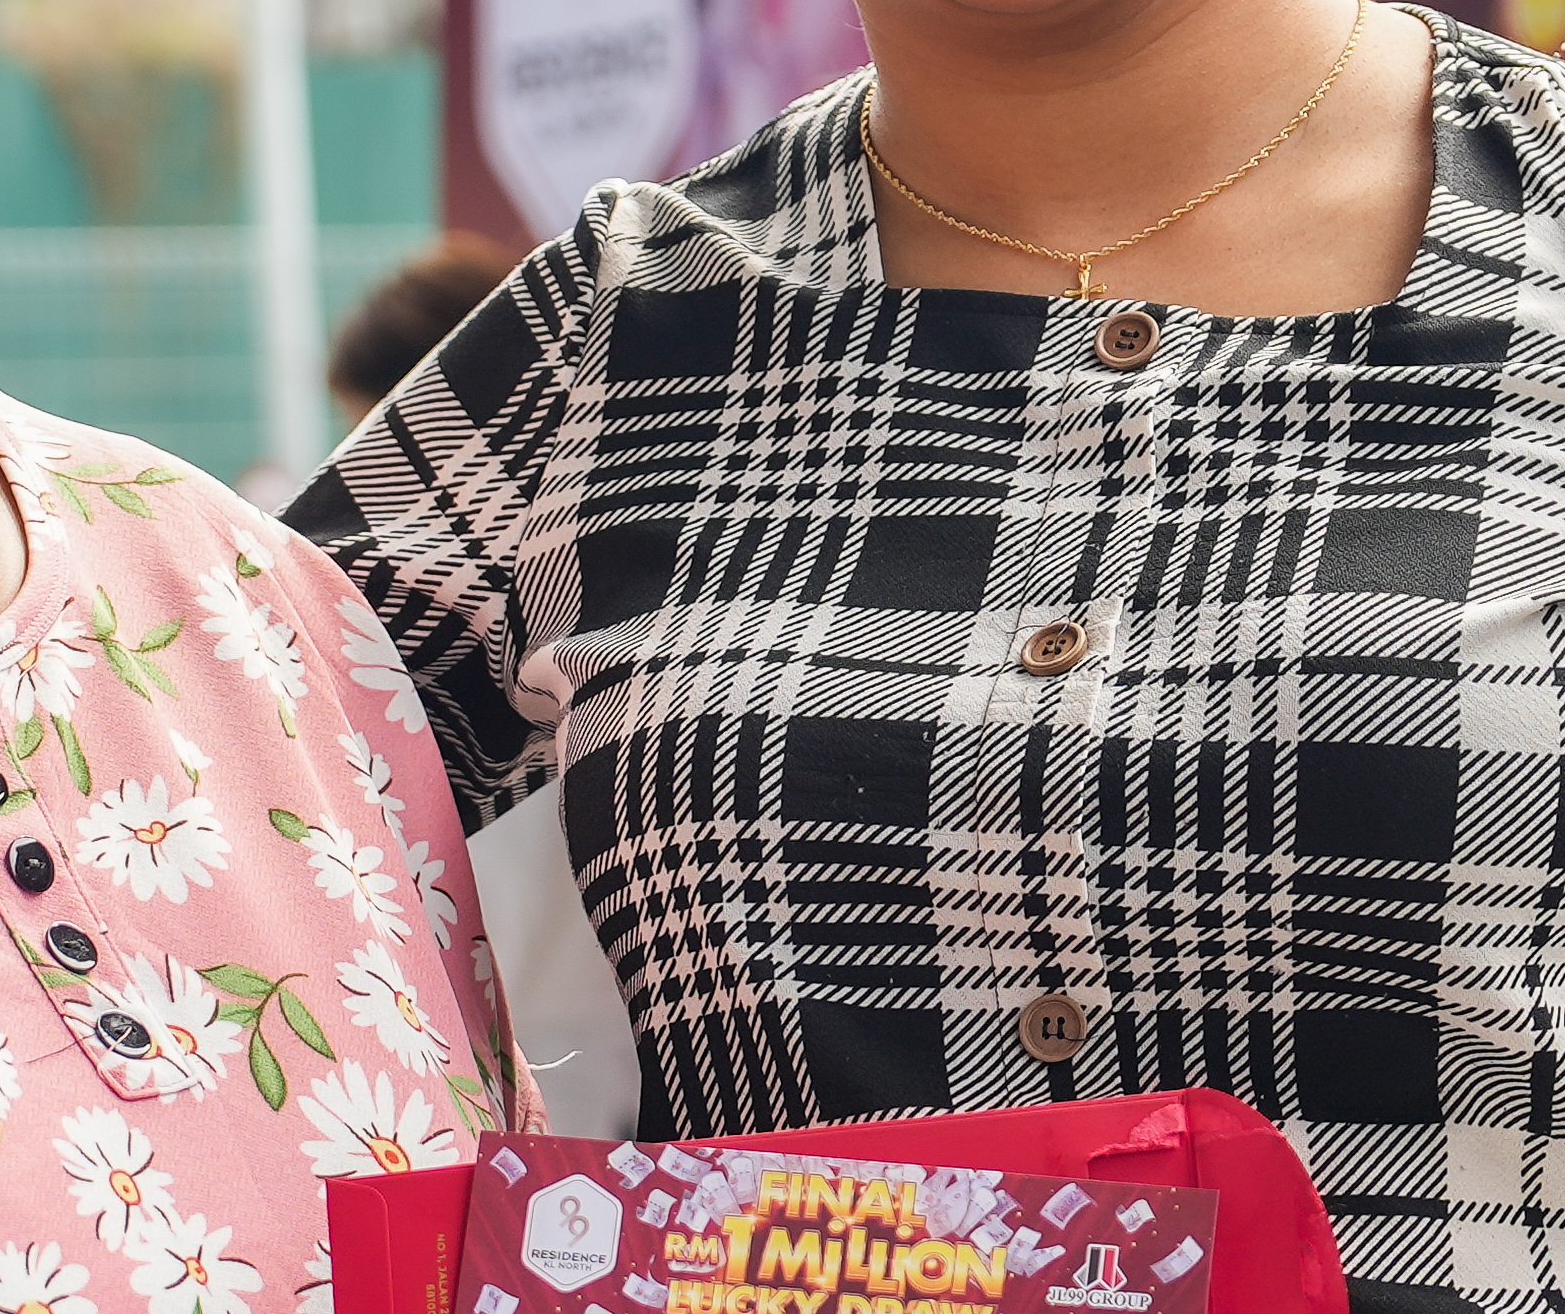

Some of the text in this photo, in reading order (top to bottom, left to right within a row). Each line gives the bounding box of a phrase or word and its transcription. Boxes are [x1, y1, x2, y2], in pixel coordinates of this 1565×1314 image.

[757, 1169, 927, 1228] FINAL
[437, 1233, 446, 1251] NO
[664, 1231, 720, 1265] RM
[723, 1213, 756, 1284] 1
[531, 1249, 607, 1264] RESIDENCE
[544, 1260, 592, 1272] KL NORTH
[438, 1266, 449, 1305] JALAN
[1089, 1290, 1149, 1308] GROUP
